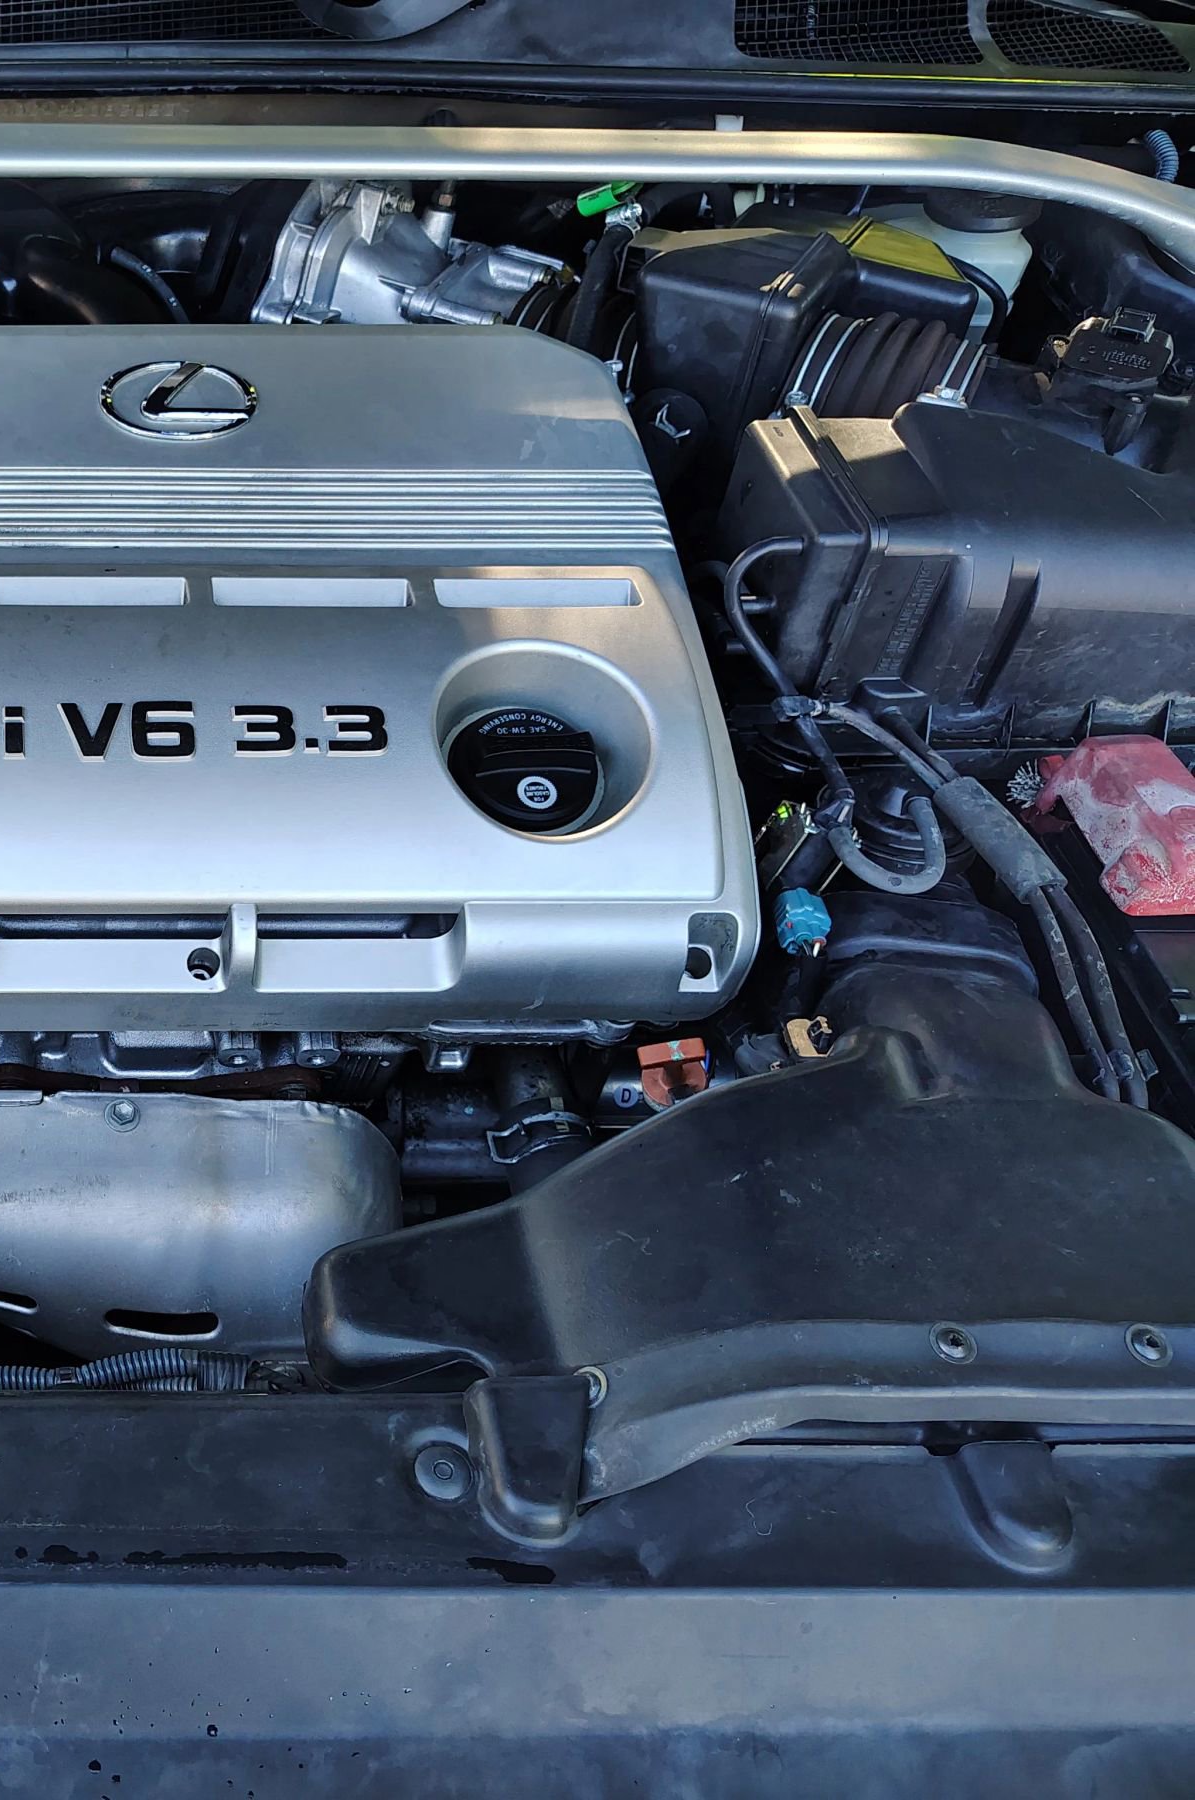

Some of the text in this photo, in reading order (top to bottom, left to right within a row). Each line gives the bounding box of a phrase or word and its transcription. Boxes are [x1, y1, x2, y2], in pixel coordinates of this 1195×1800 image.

[58, 701, 195, 761] V6
[231, 704, 389, 757] 3.3
[478, 713, 564, 734] ENERGY CONSERVING
[496, 726, 547, 735] SAE 5W-30
[621, 1088, 632, 1103] D
